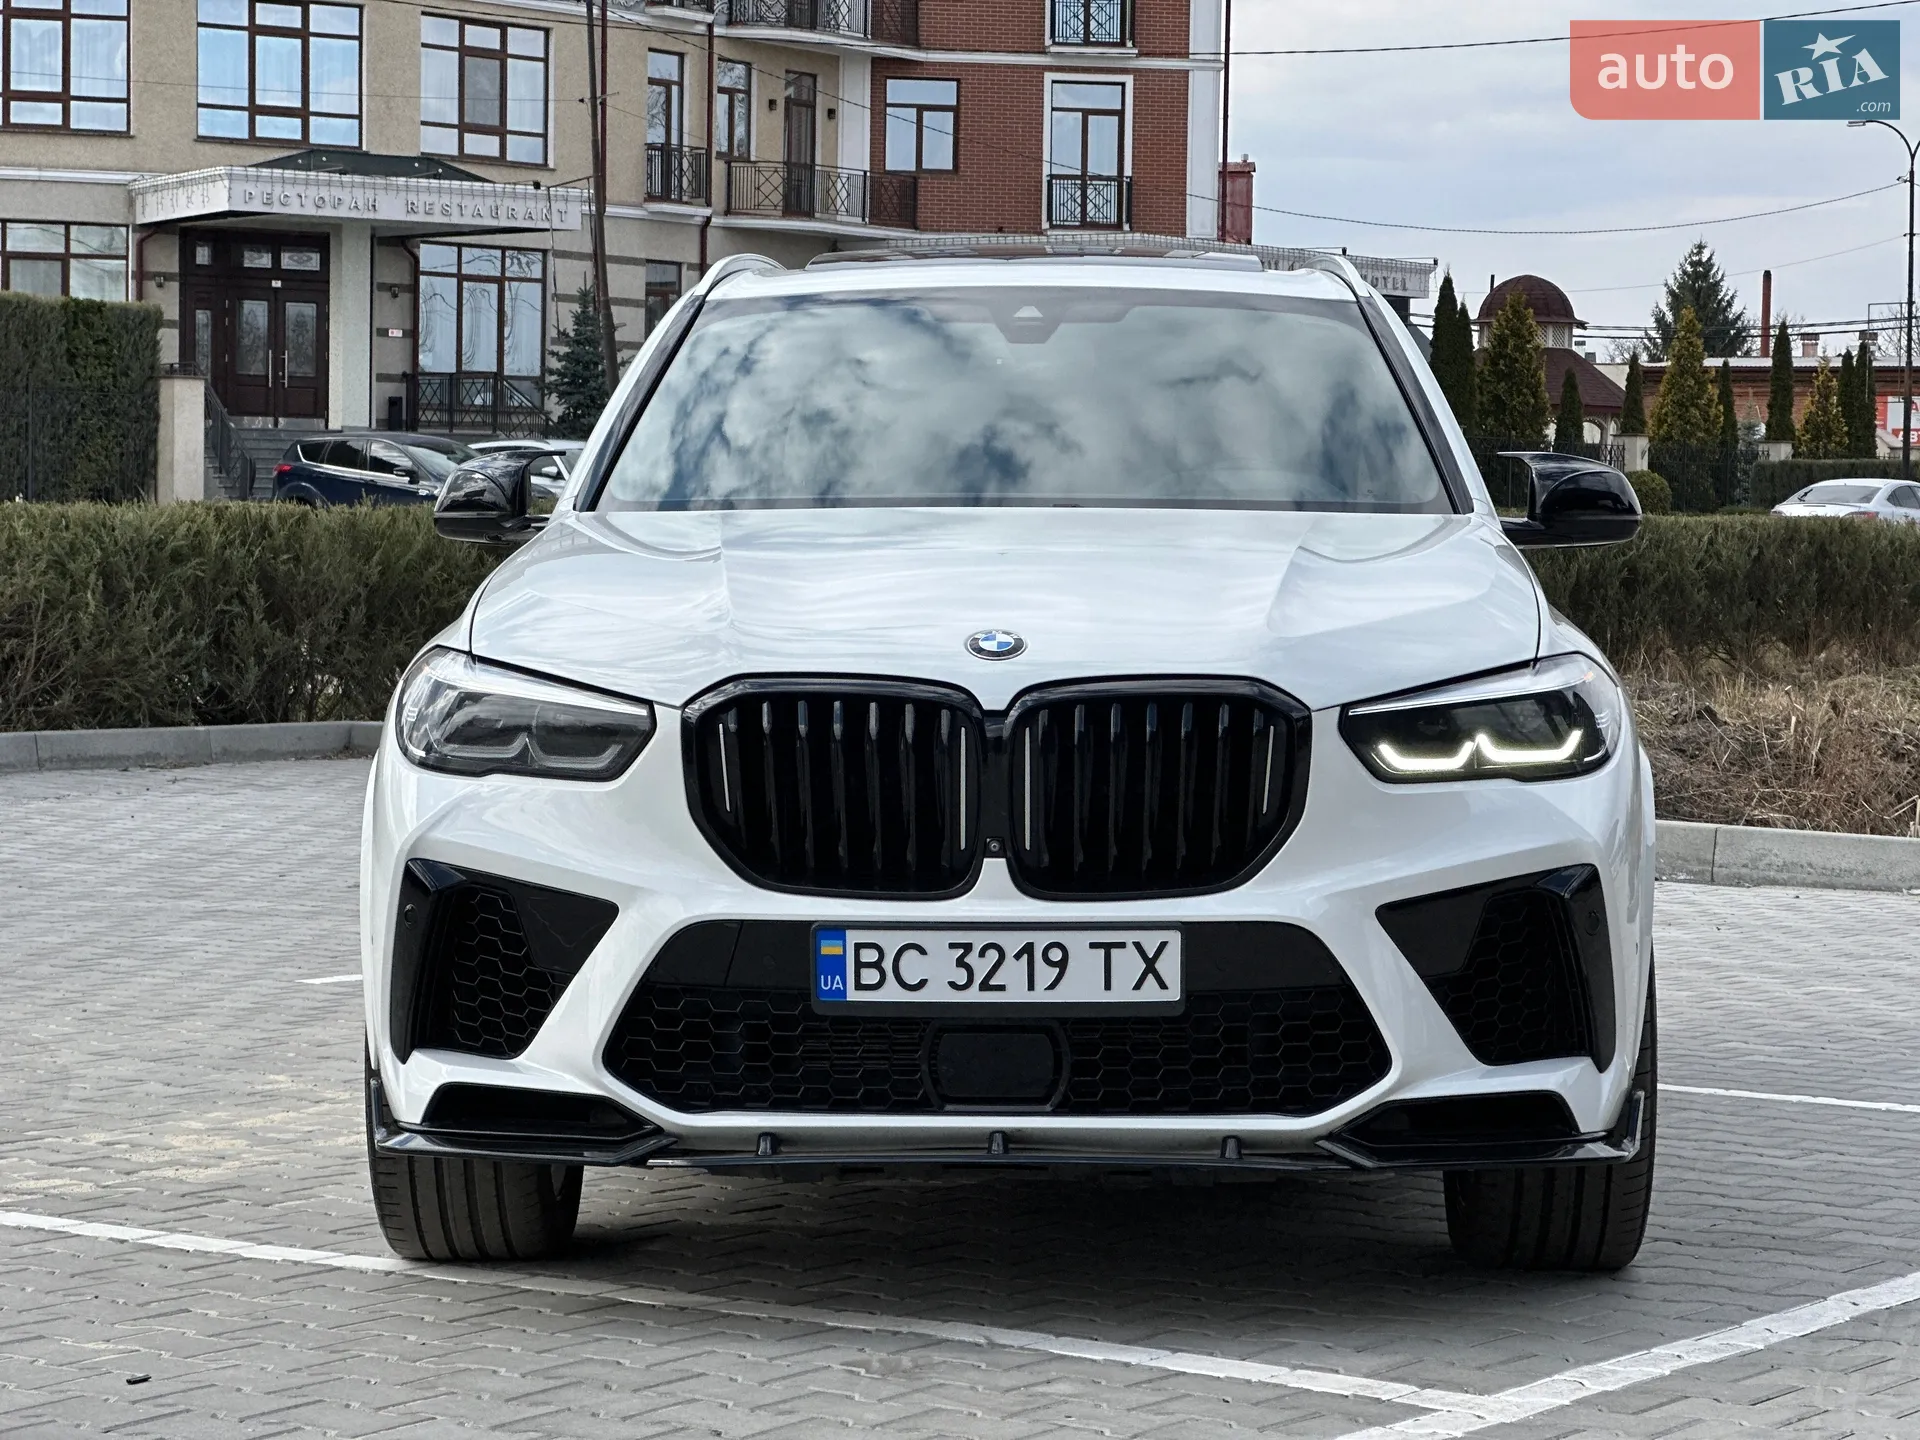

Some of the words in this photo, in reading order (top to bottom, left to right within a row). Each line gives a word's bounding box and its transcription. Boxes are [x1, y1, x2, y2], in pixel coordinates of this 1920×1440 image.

[244, 189, 379, 212] РЕСТОРАН
[406, 199, 568, 223] RESTAURANT
[852, 941, 929, 992] BC
[946, 941, 1070, 992] 3219
[1088, 941, 1170, 991] TX
[820, 974, 844, 991] UA
